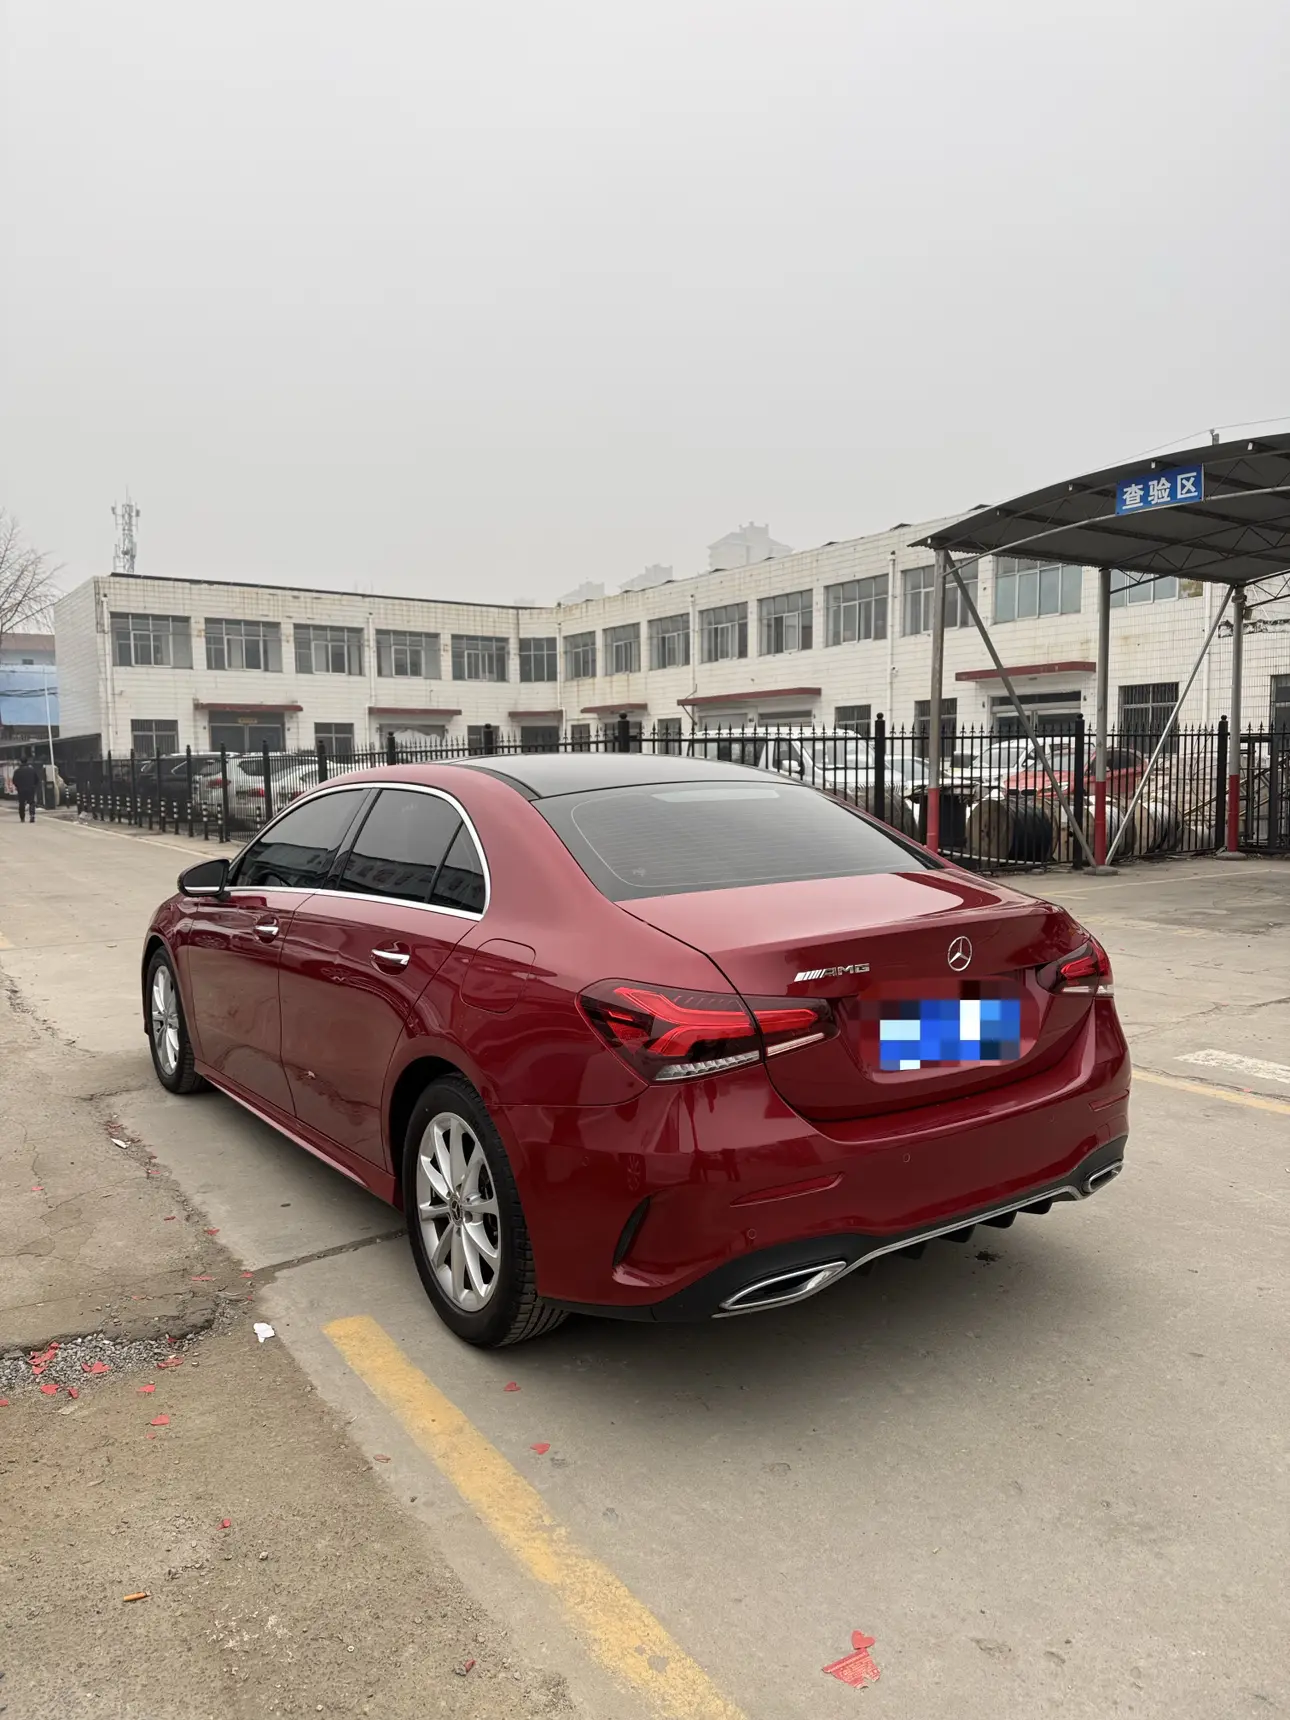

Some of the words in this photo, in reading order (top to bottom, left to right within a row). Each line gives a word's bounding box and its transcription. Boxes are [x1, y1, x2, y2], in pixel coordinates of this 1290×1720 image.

[1122, 472, 1198, 509] 查验区
[824, 962, 870, 977] AMG
